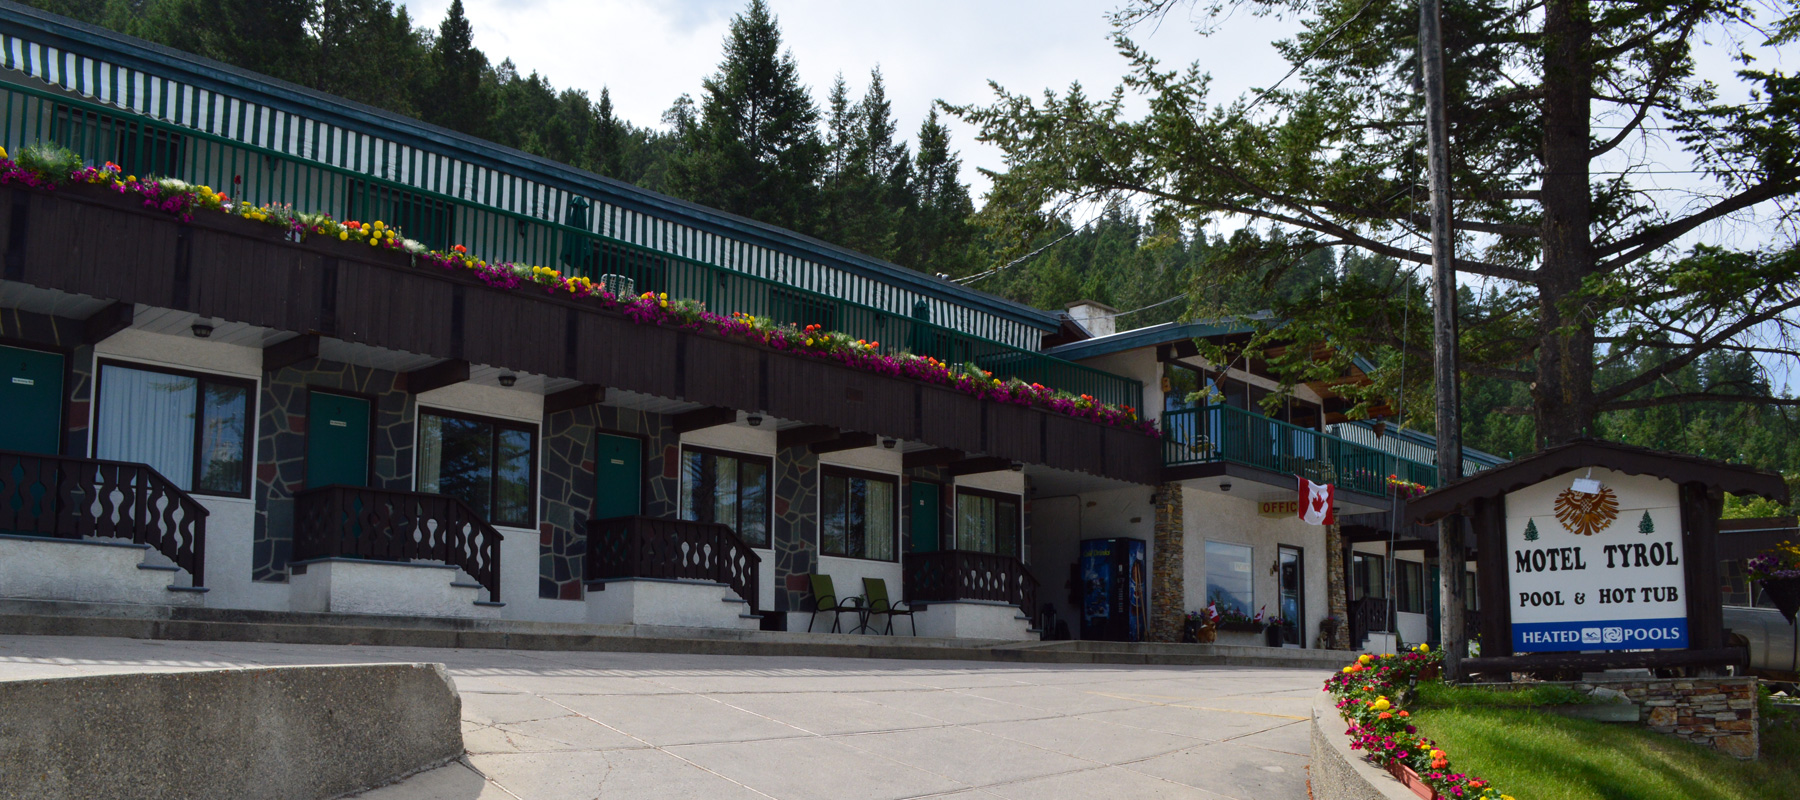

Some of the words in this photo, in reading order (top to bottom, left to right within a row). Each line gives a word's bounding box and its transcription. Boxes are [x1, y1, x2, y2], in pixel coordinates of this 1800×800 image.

[1263, 501, 1297, 513] OFFIC
[1515, 547, 1586, 573] MOTEL
[1603, 541, 1679, 568] TYROL
[1519, 591, 1565, 607] POOL
[1574, 592, 1586, 605] &
[1599, 587, 1636, 604] HOT
[1640, 586, 1679, 603] TUB
[1522, 630, 1580, 644] HEATED
[1624, 627, 1680, 641] POOLS
